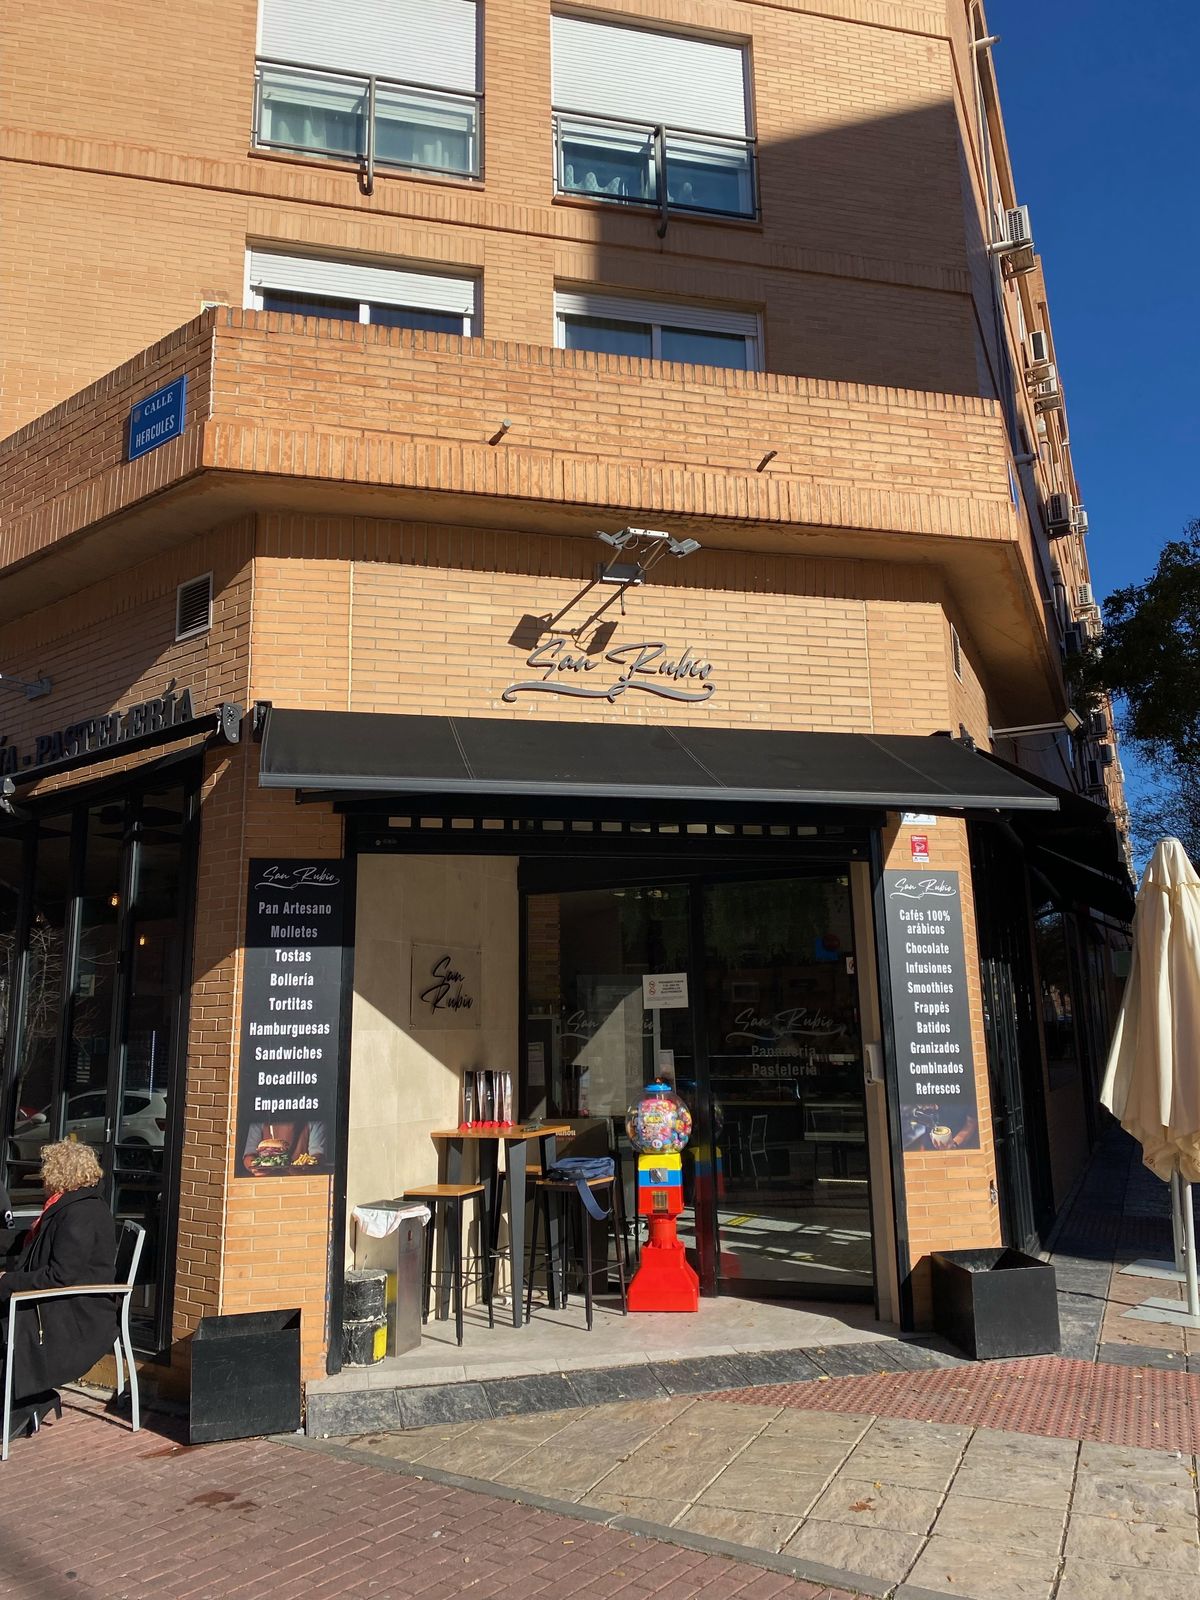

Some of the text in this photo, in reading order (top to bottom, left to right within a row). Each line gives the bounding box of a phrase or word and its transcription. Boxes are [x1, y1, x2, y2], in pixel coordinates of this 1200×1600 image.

[144, 391, 174, 416] CALLE
[135, 414, 175, 448] HERCULES
[526, 638, 714, 682] San Rubio
[35, 677, 194, 766] PASTELERÍA
[262, 866, 335, 882] San Rubio
[894, 878, 953, 894] San Rubio
[258, 902, 332, 914] Pan Artesano
[899, 909, 951, 922] Cafés 100%
[270, 925, 318, 938] Molletes
[907, 922, 945, 935] arábicos
[905, 942, 950, 954] Chocolate
[275, 949, 312, 962] Tostas
[432, 955, 465, 985] San
[905, 962, 952, 974] Infusiones
[270, 972, 314, 986] Bollería
[907, 982, 954, 994] Smoothies
[269, 997, 313, 1011] Tortitas
[421, 983, 474, 1015] Rubio
[914, 1001, 950, 1016] Frappés
[734, 1006, 835, 1031] San Rubio
[249, 1022, 330, 1037] Hamburguesas
[916, 1021, 951, 1034] Batidos
[255, 1046, 323, 1061] Sandwiches
[910, 1041, 960, 1054] Granizados
[909, 1062, 964, 1075] Combinados
[258, 1071, 318, 1085] Bocadillos
[916, 1082, 961, 1095] Refrescos
[254, 1096, 319, 1113] Empanadas
